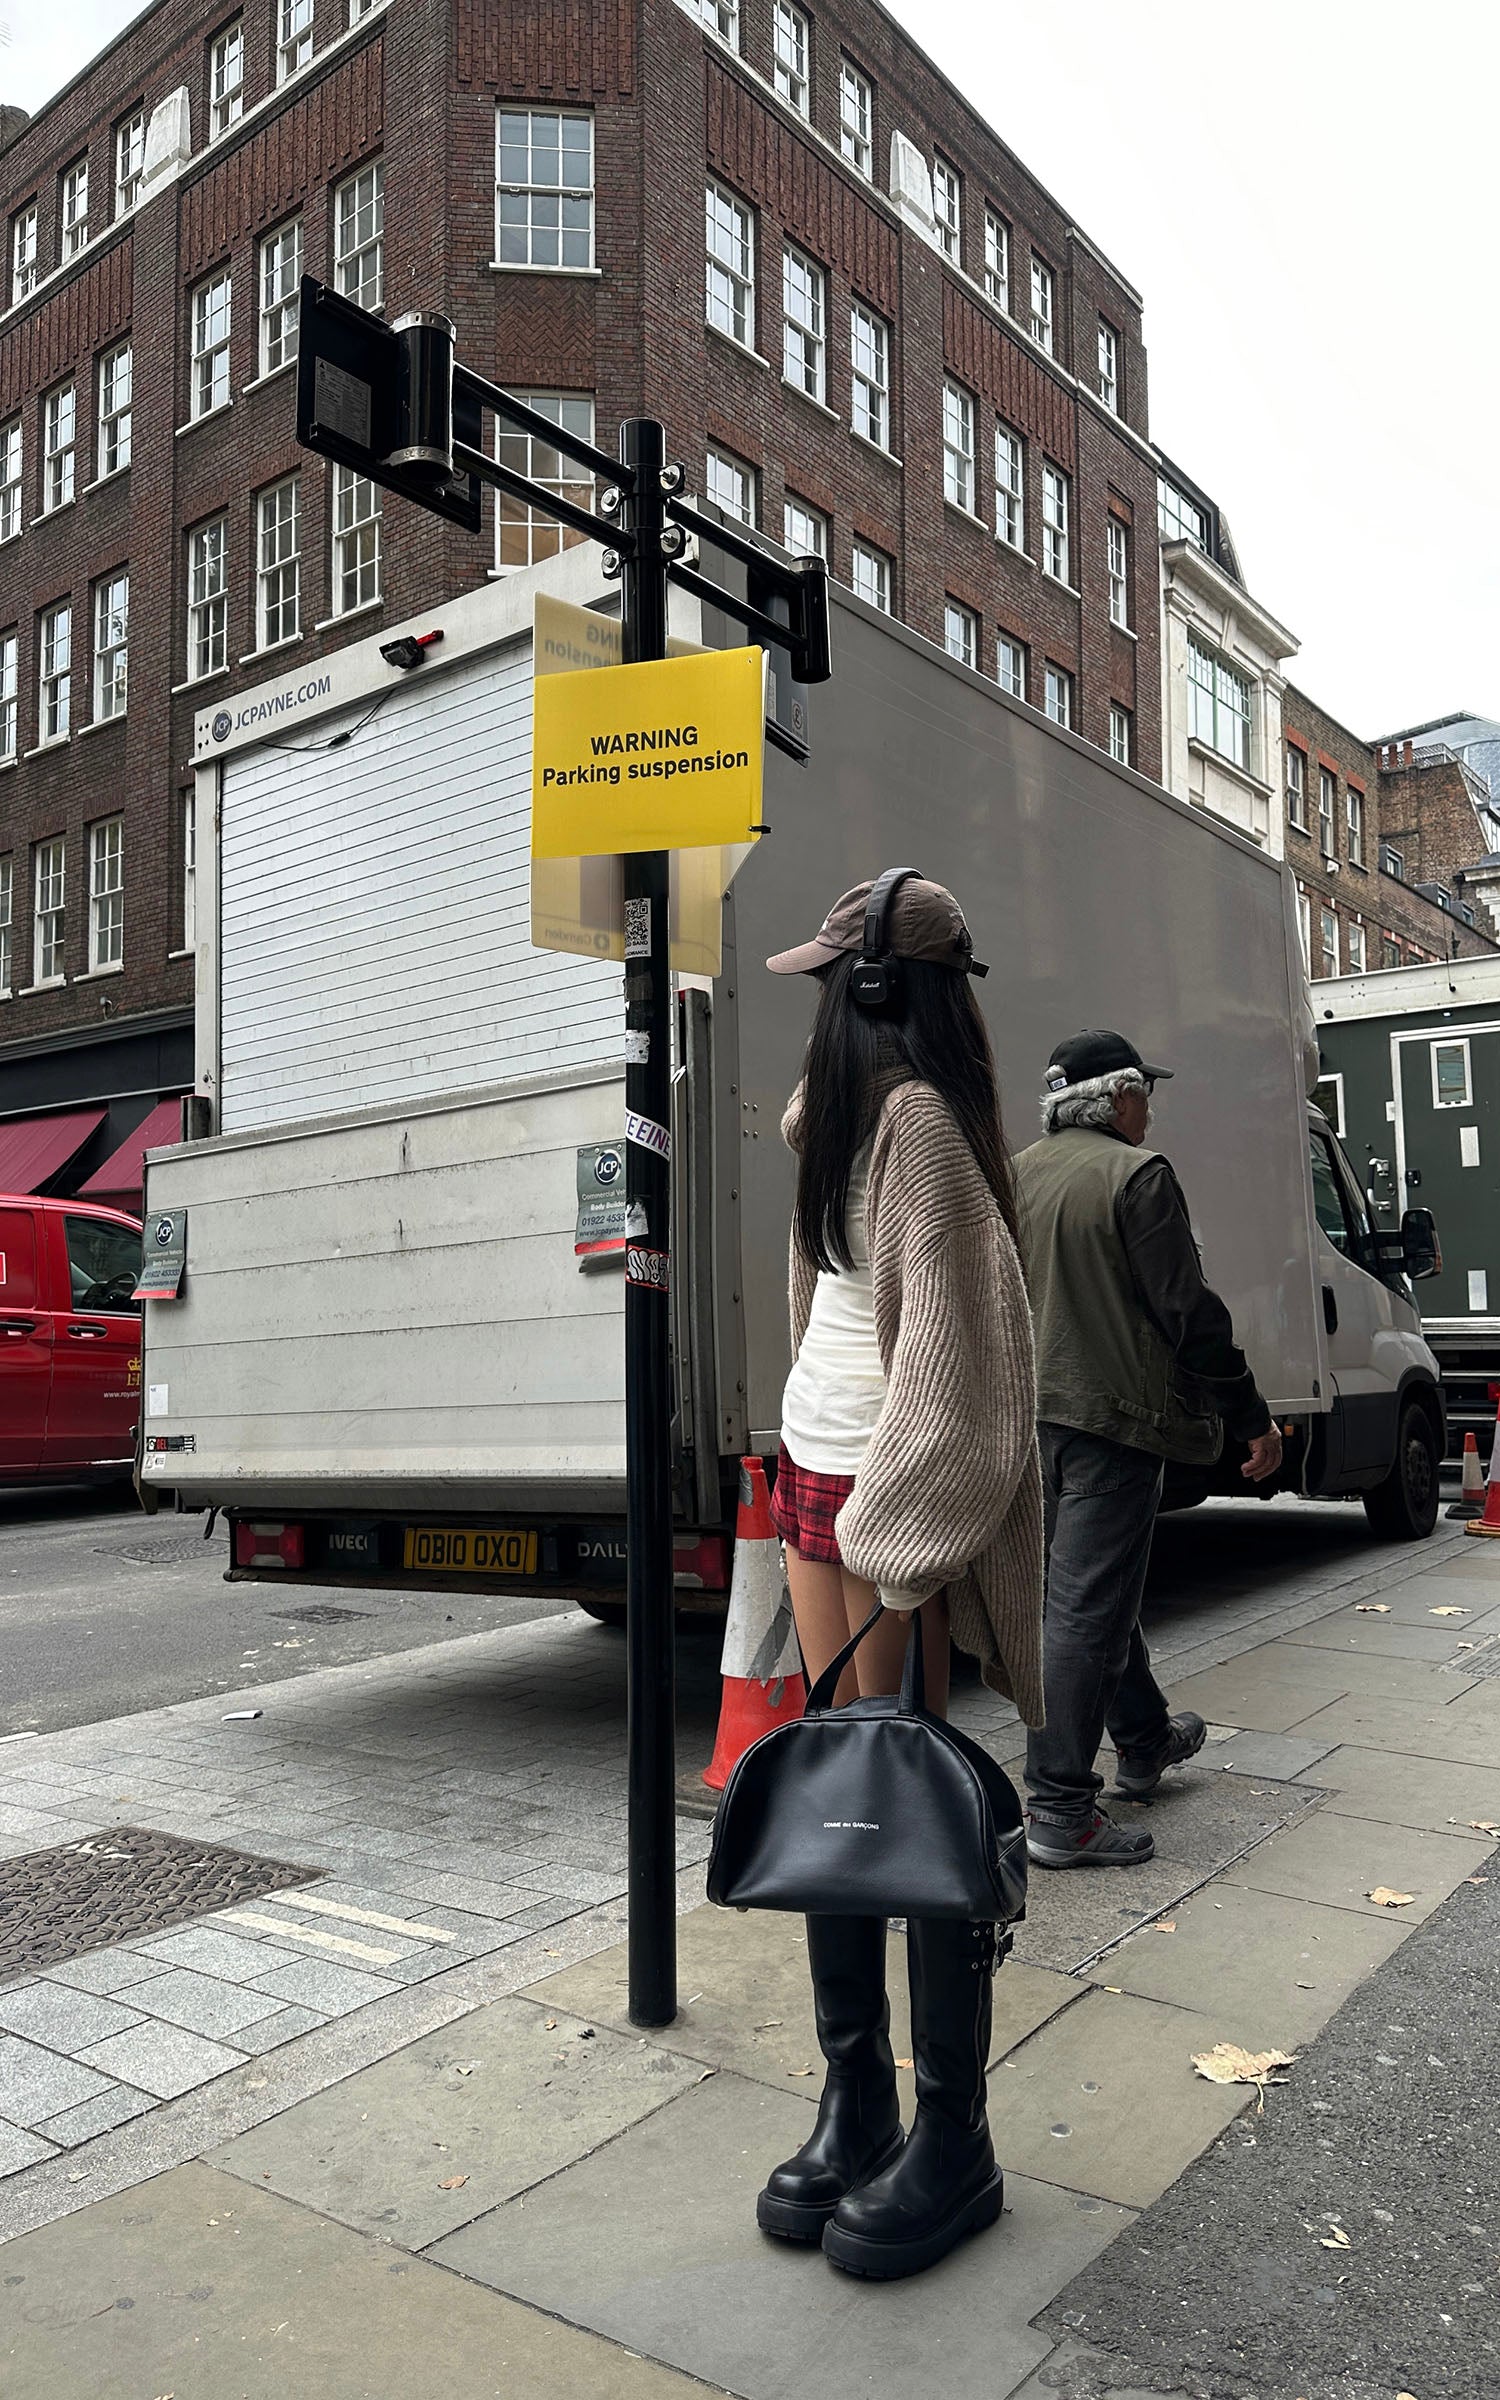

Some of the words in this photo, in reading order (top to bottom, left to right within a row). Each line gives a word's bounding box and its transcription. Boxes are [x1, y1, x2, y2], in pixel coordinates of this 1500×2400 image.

[235, 675, 331, 731] JCPAYNE.COM
[591, 726, 699, 756] WARNING
[543, 764, 621, 787] Parking
[628, 750, 749, 780] suspension
[598, 1160, 618, 1175] JCP
[582, 1190, 616, 1201] Commercial
[590, 1203, 606, 1212] Body
[606, 1201, 626, 1209] Builder
[582, 1215, 606, 1226] 01922
[606, 1213, 626, 1223] 4533
[417, 1533, 467, 1565] OB10
[473, 1535, 523, 1567] OXO
